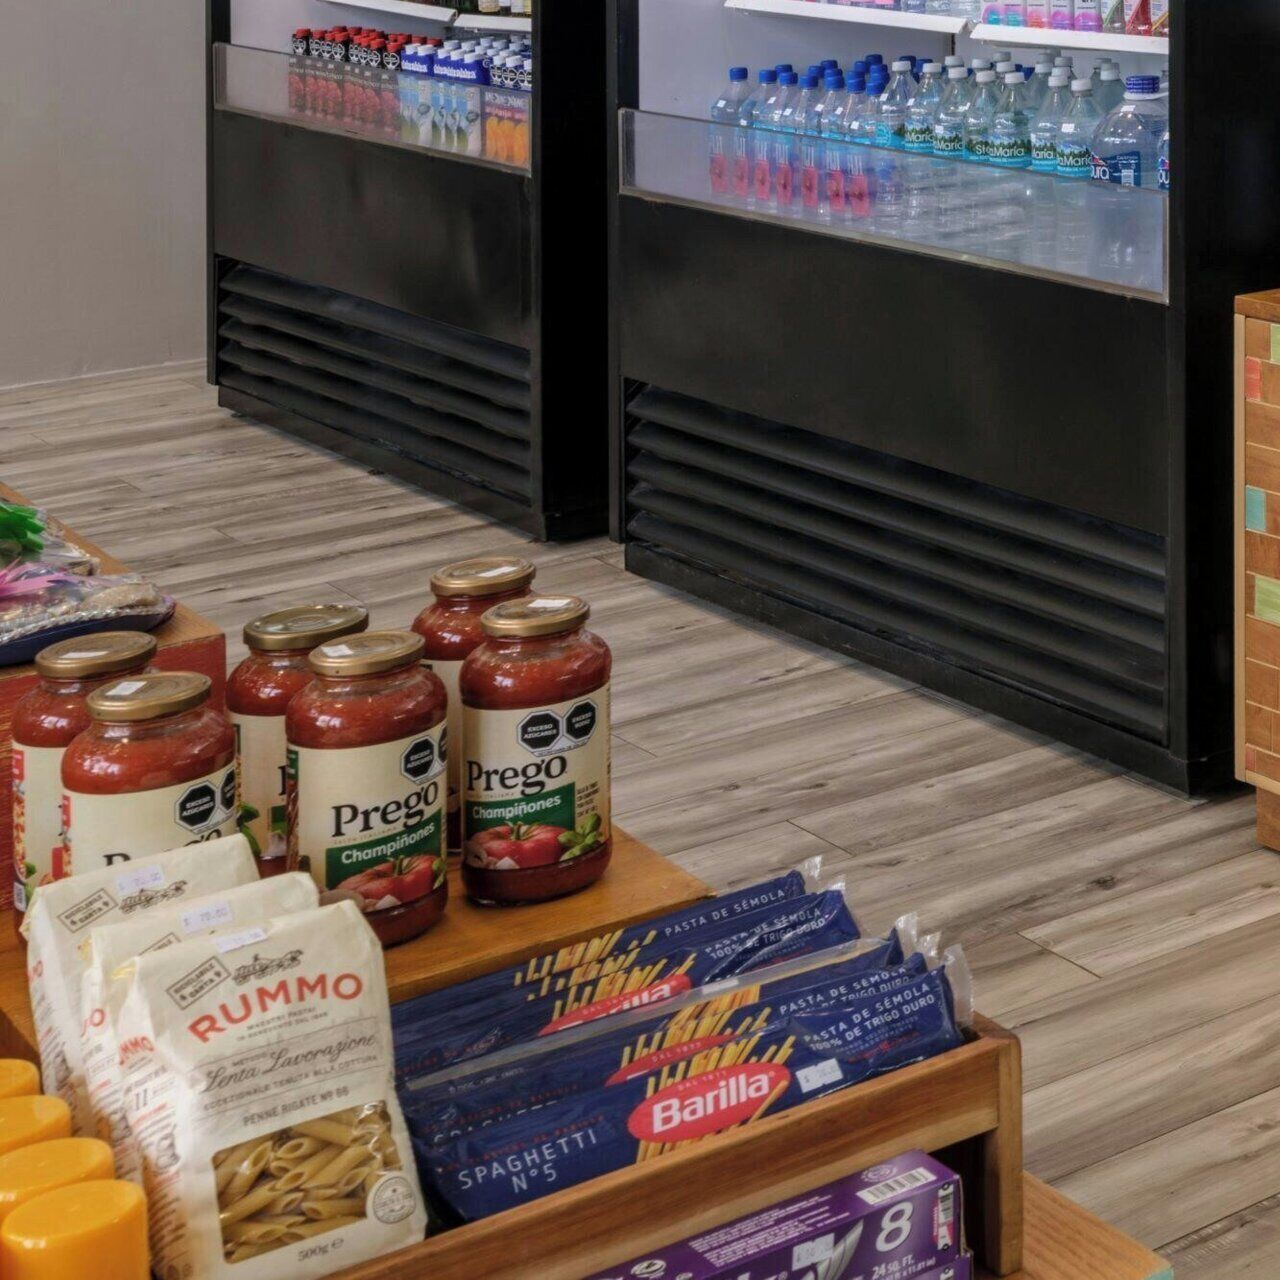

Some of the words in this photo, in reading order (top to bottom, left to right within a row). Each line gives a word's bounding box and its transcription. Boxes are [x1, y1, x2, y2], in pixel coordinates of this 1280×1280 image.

[466, 755, 567, 797] Prego
[331, 780, 439, 838] Prego
[473, 794, 562, 819] Champiñones
[341, 822, 436, 865] Champiñones
[664, 918, 707, 936] PASTA
[712, 908, 729, 921] DE
[733, 887, 786, 913] SÉMOLA
[188, 973, 363, 1044] RUMMO
[779, 992, 824, 1016] PASTA
[829, 983, 848, 998] DE
[852, 965, 907, 991] SÉMOLA
[803, 1021, 848, 1044] PASTA
[852, 1010, 870, 1024] DE
[875, 982, 931, 1012] SÉMOLA
[809, 1036, 844, 1052] 100%
[846, 1027, 862, 1042] DE
[864, 1009, 901, 1034] TRIGO
[904, 993, 936, 1012] DURO
[263, 1034, 377, 1075] Lavorazione
[651, 1072, 771, 1135] Barilla
[457, 1127, 599, 1191] SPAGHETTI
[875, 1201, 914, 1252] 8
